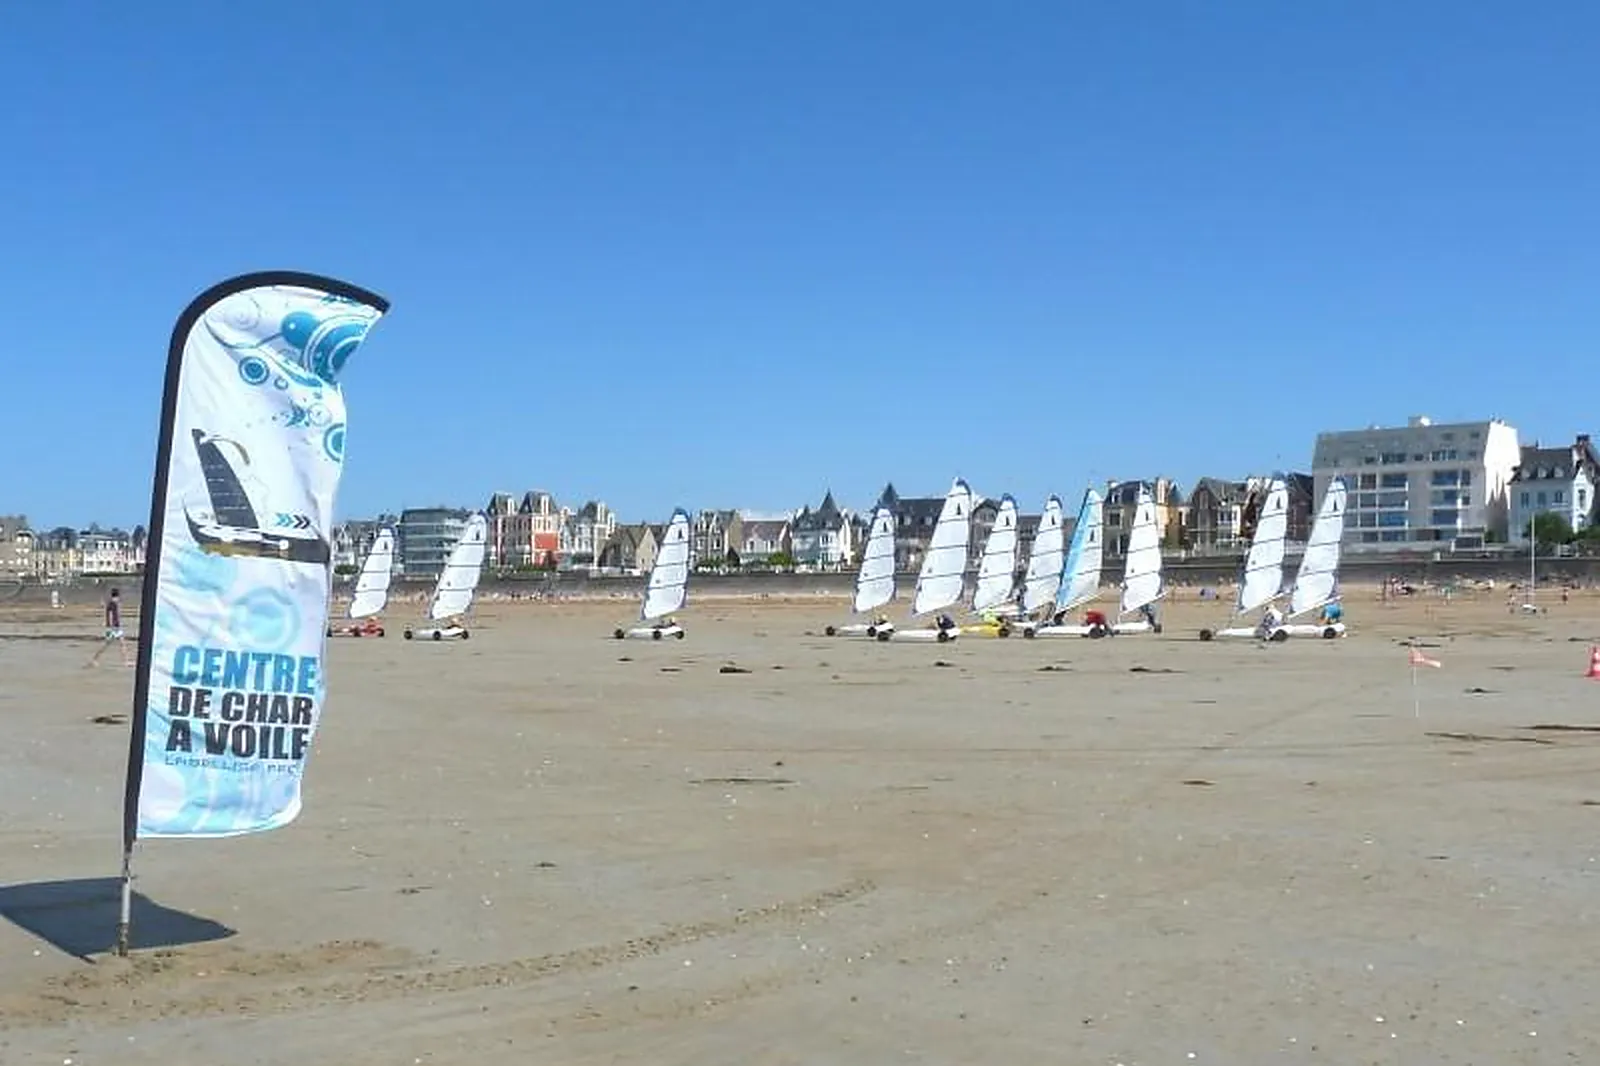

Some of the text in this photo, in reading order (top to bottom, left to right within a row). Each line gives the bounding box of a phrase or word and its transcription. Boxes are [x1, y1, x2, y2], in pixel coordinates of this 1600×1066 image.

[172, 645, 318, 694] CENTRE
[169, 686, 313, 725] DE CHAR
[165, 719, 192, 753] A
